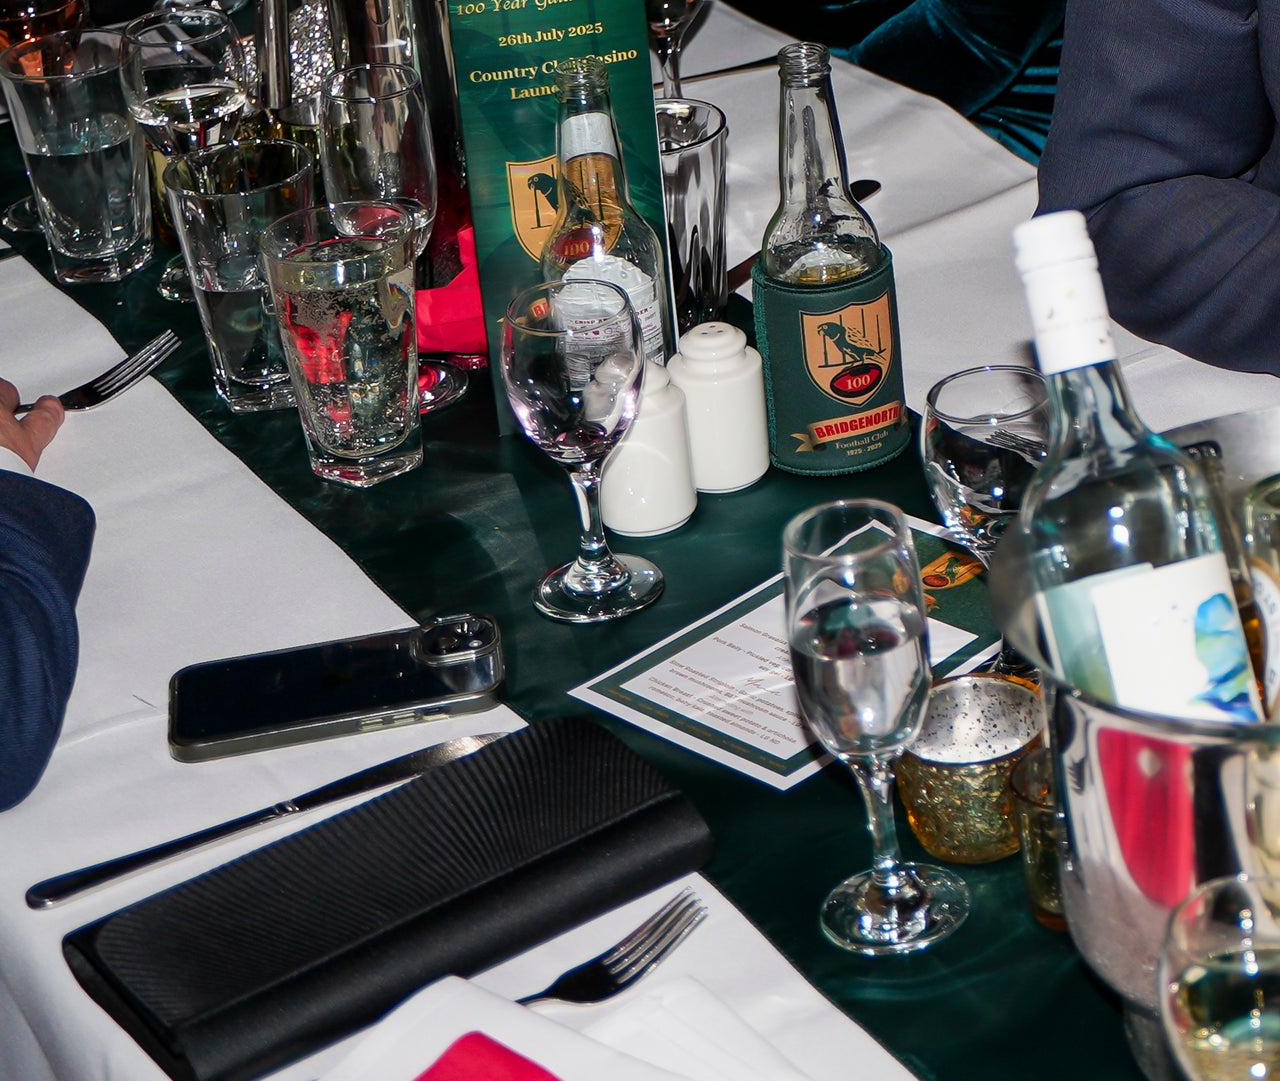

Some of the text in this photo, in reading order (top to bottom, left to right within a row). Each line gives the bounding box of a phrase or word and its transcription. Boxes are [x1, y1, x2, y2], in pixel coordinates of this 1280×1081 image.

[457, 2, 486, 16] 100
[499, 22, 603, 46] 26th July 2025
[469, 65, 538, 83] Country
[541, 56, 584, 73] Cl
[846, 375, 871, 390] 100
[814, 405, 899, 439] BRIDGENORTH
[835, 430, 889, 449] Football Club
